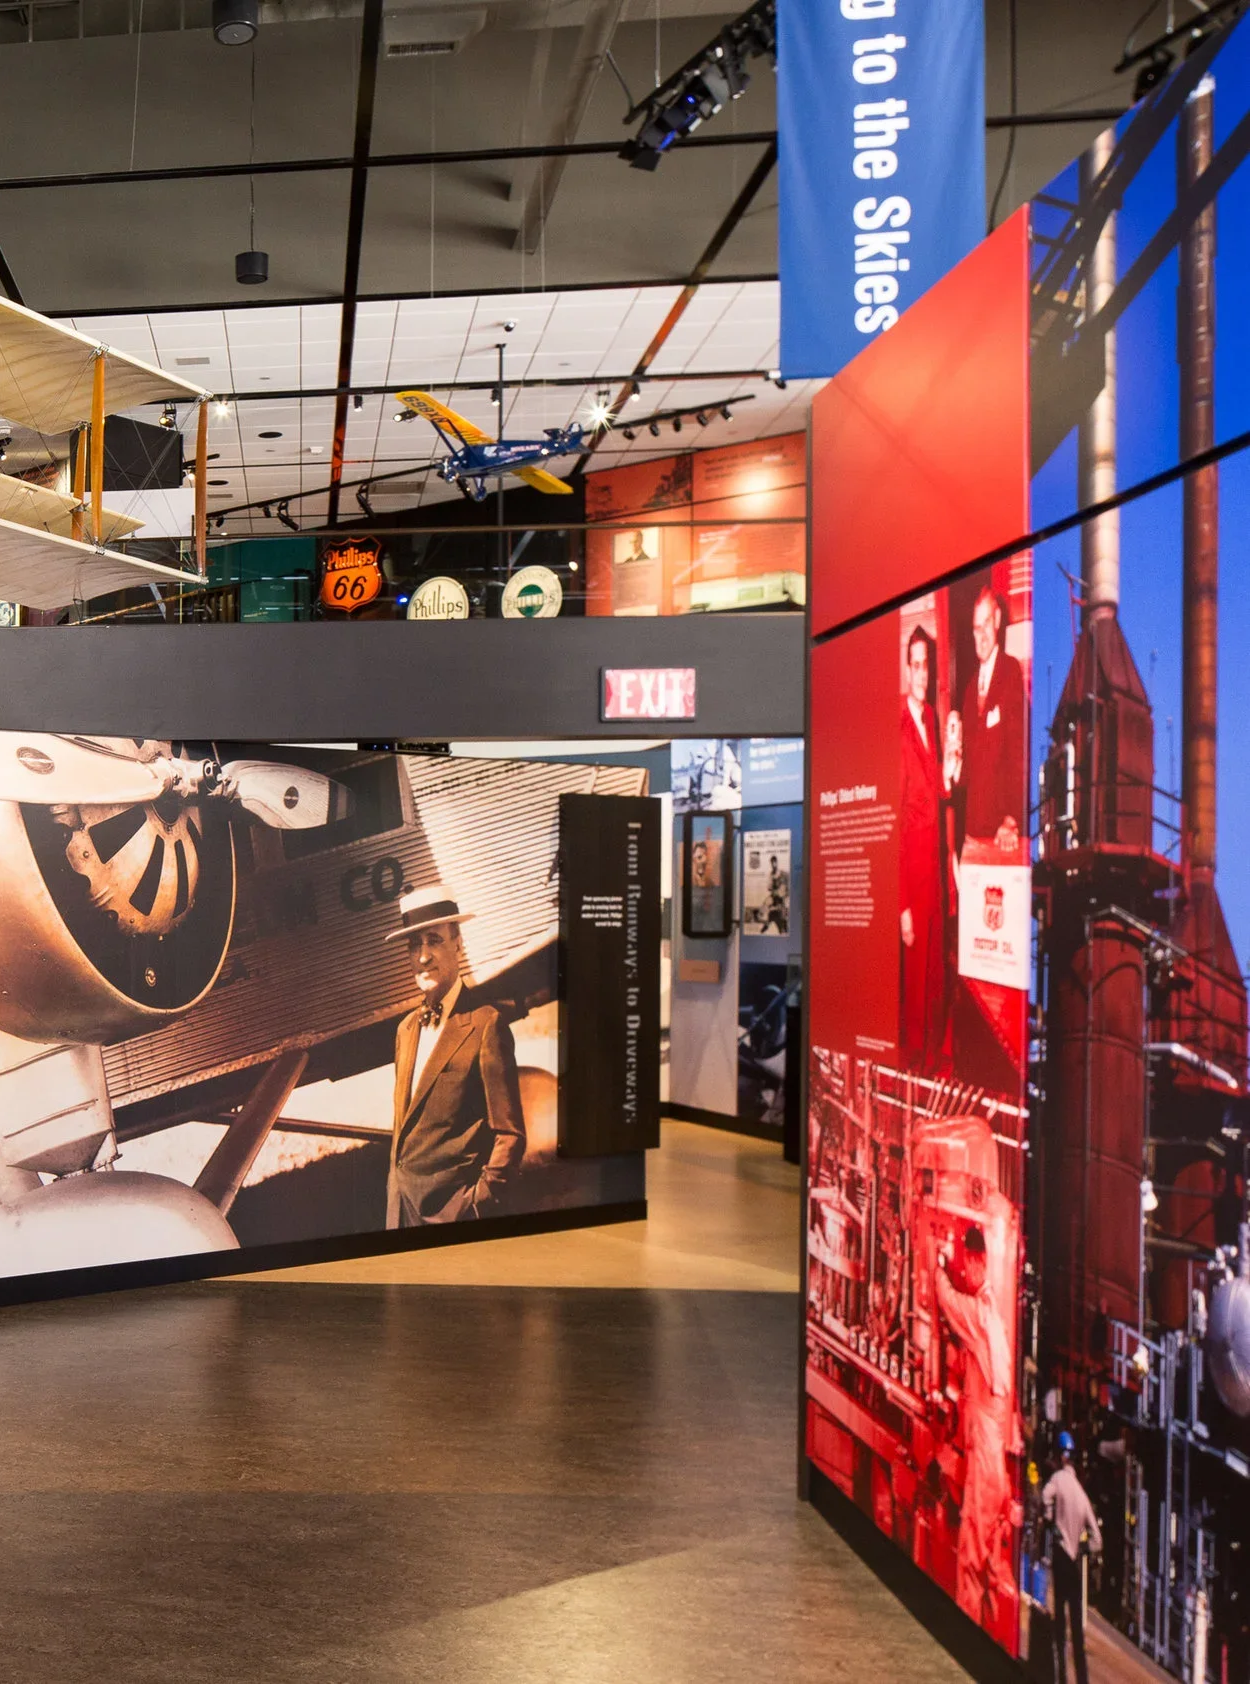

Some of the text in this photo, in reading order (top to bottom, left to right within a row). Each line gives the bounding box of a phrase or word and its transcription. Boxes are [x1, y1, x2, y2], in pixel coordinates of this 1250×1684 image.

[852, 33, 907, 85] to
[853, 97, 910, 180] the
[852, 196, 912, 335] Skies
[326, 547, 375, 570] Phillips
[333, 575, 367, 600] 66
[413, 584, 463, 618] Phillips
[620, 672, 685, 717] EXIT
[626, 987, 640, 1006] to
